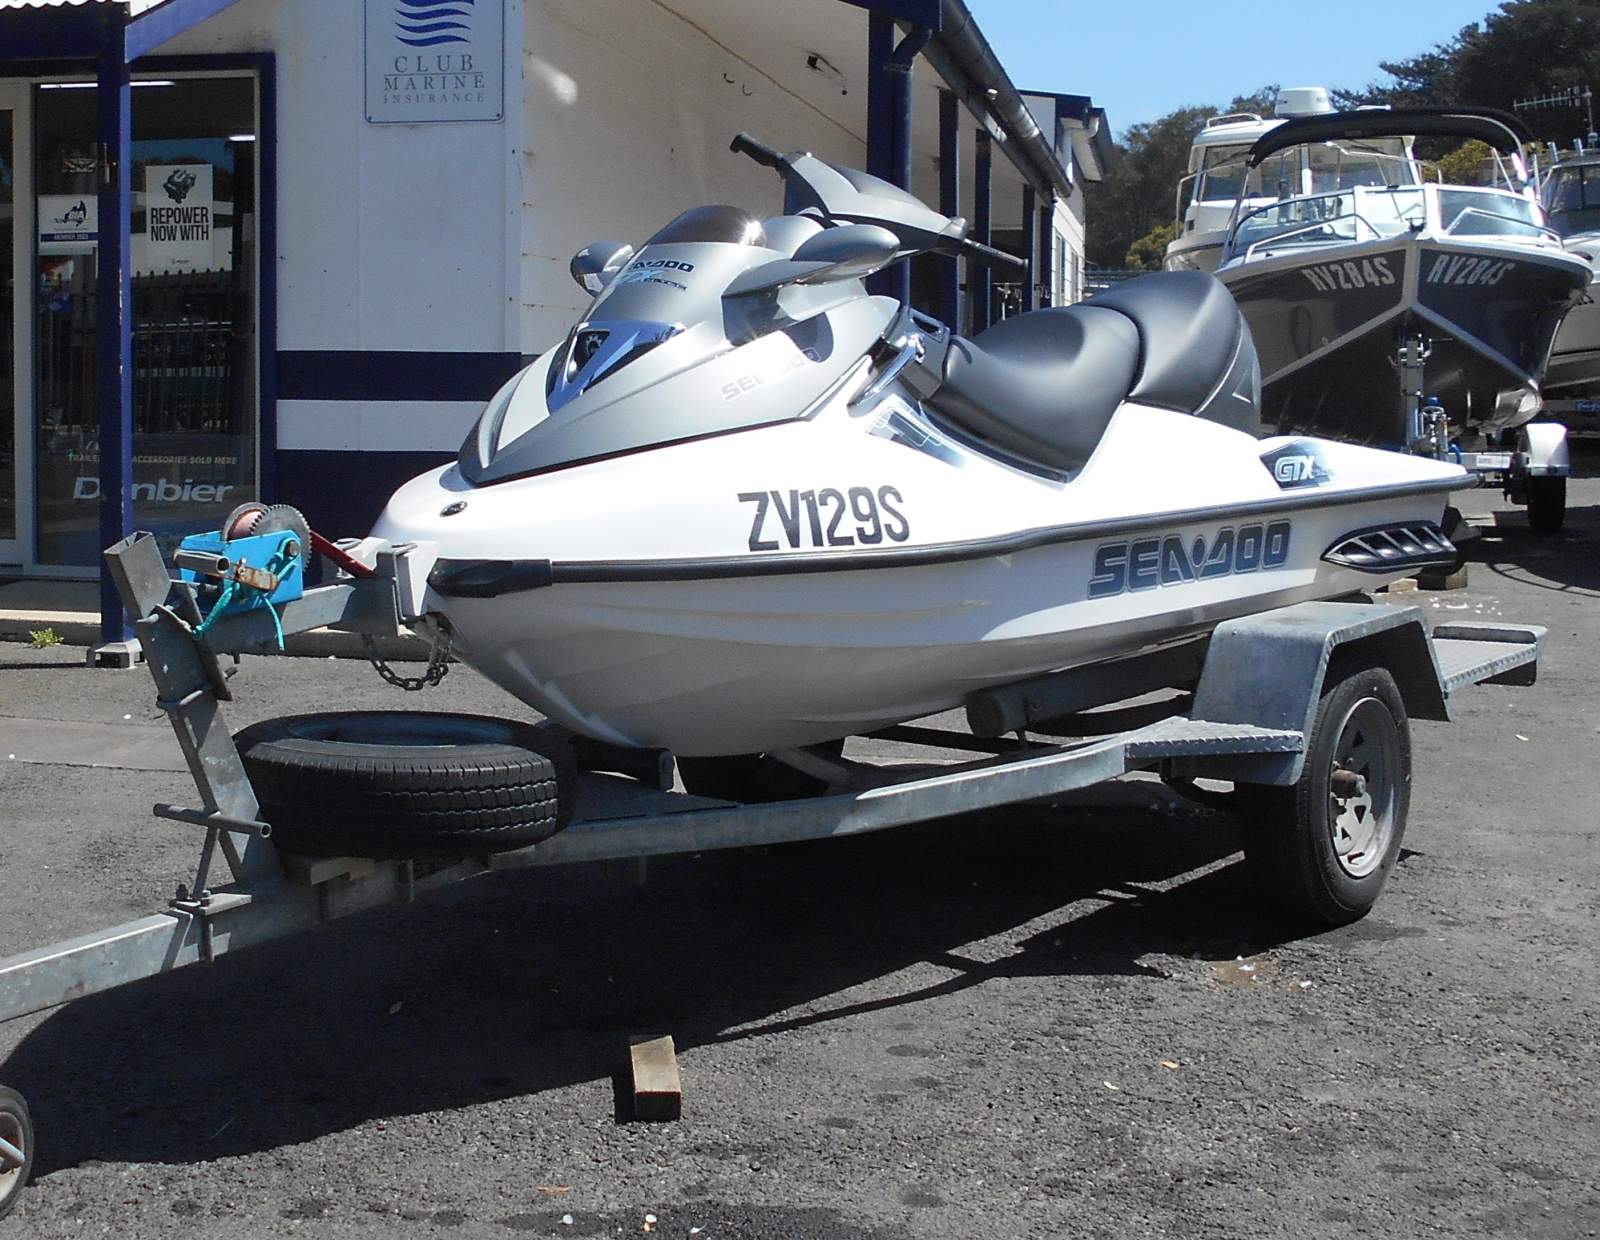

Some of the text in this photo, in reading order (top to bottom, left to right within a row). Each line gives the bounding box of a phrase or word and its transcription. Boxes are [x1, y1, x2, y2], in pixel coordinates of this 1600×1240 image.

[394, 54, 473, 73] CLUB
[383, 75, 485, 91] MARINE
[383, 93, 485, 104] INSURANCE
[151, 207, 209, 225] REPOWER
[151, 225, 209, 241] NOW WITH
[1301, 256, 1396, 292] RV284S
[1426, 254, 1515, 286] RV284S
[132, 456, 187, 464] ACCESSORIES
[190, 456, 212, 465] SOLD
[214, 456, 238, 465] HERE
[1275, 455, 1315, 482] GTX
[73, 476, 234, 503] Dnbier
[737, 484, 910, 552] ZV129S
